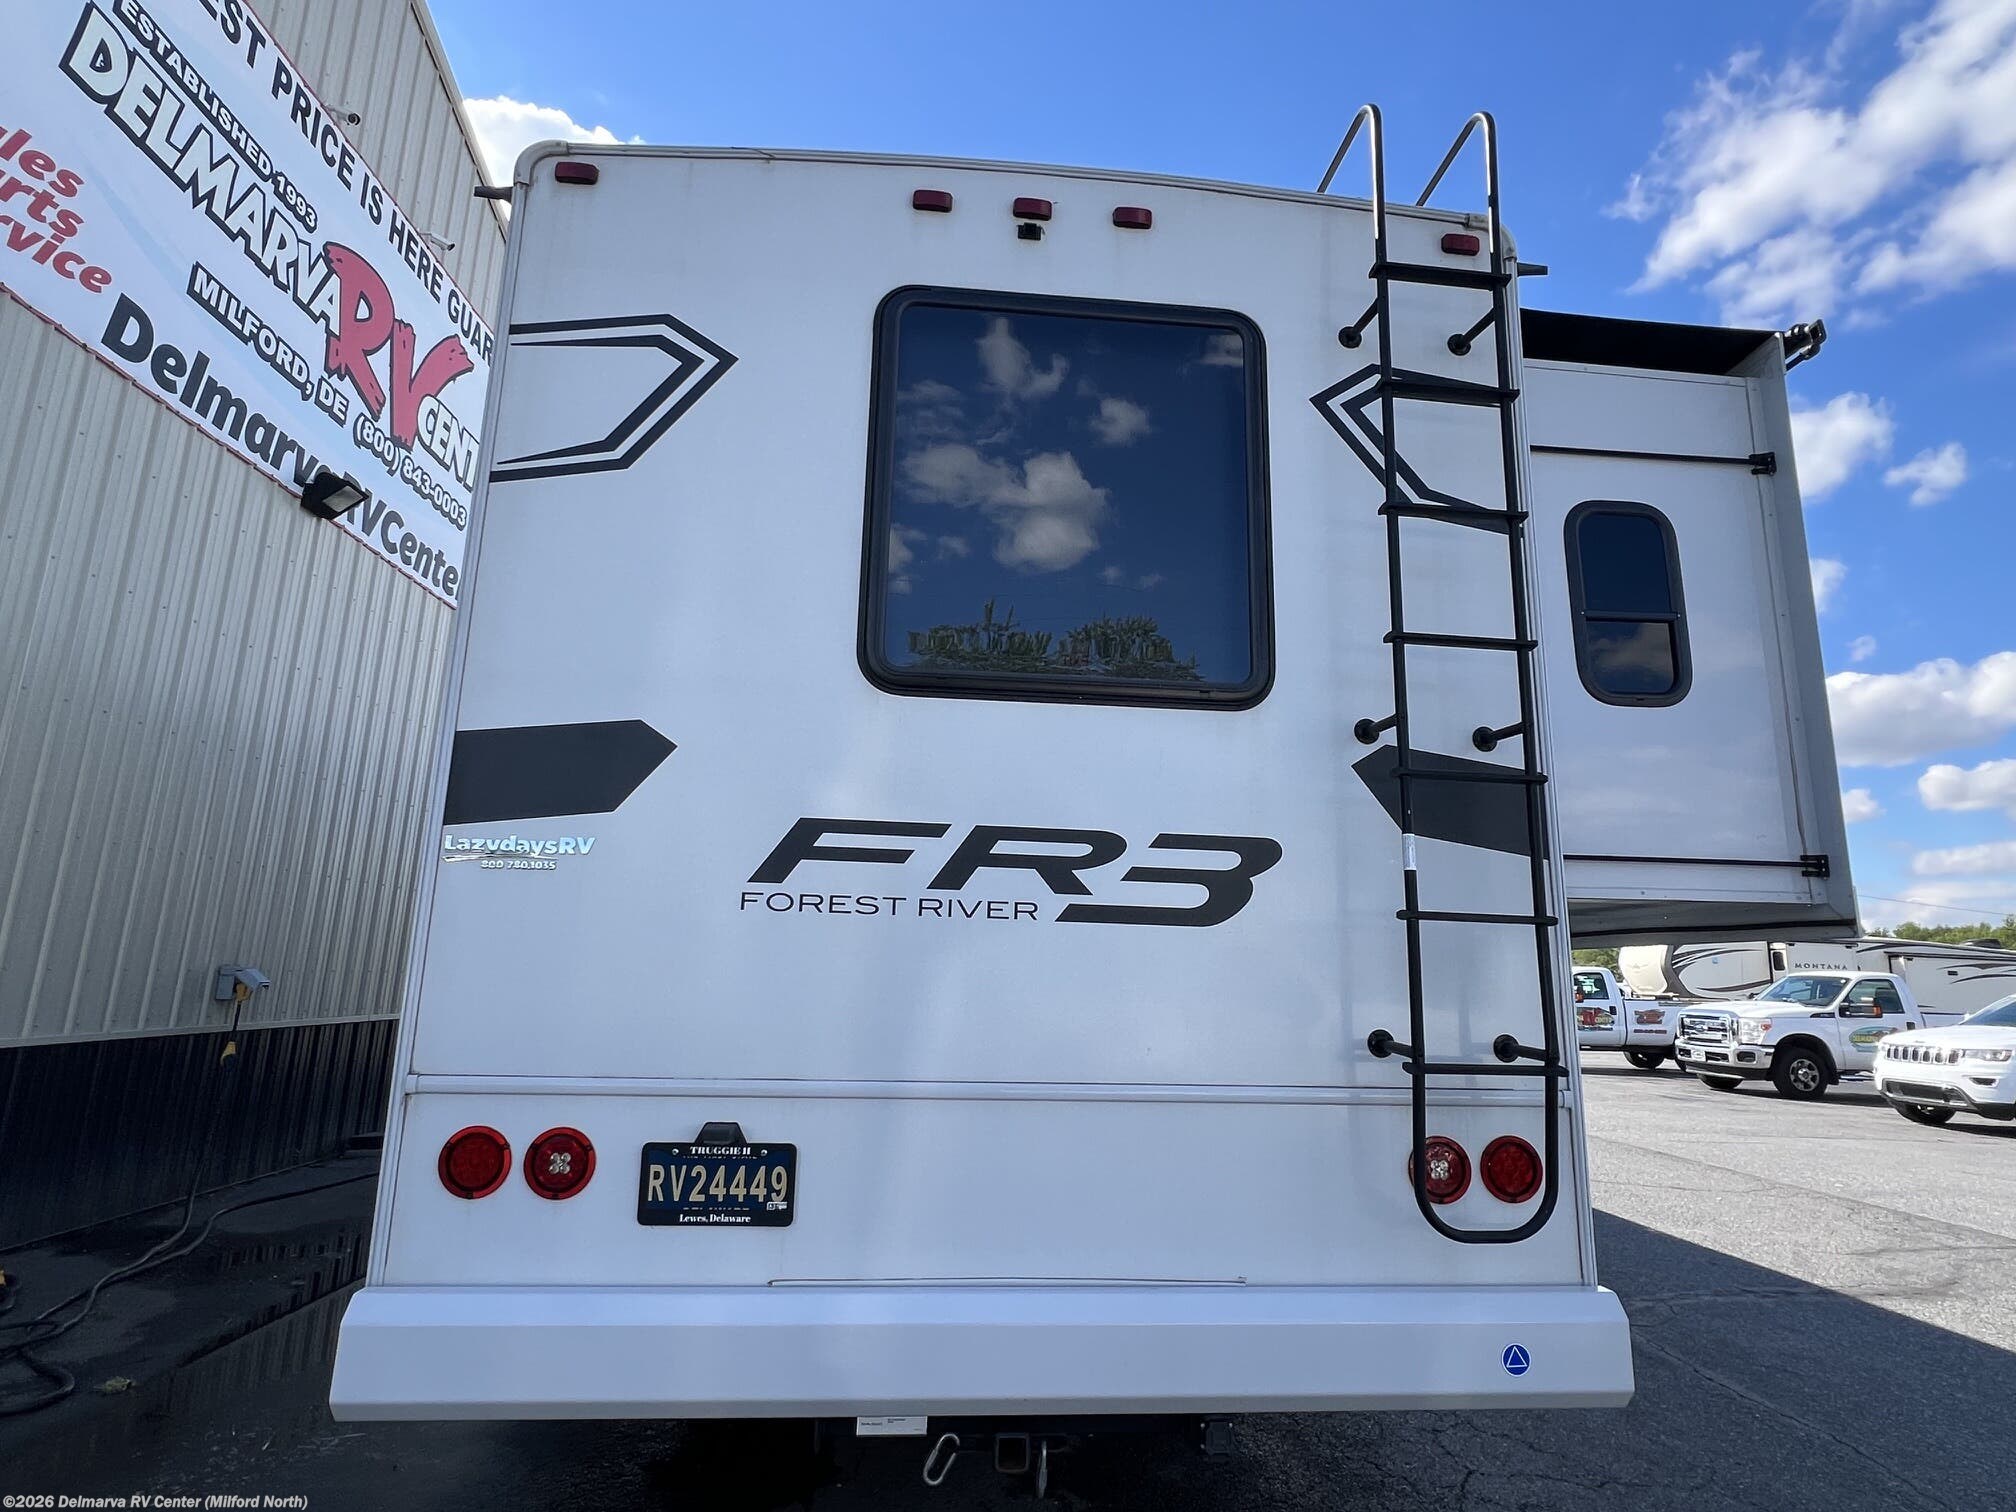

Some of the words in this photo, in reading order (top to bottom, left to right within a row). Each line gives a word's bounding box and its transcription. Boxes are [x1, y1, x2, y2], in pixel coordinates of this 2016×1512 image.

[116, 0, 273, 182] ESTABLISHED
[274, 170, 318, 233] 1993
[0, 127, 85, 198] les
[272, 56, 356, 192] PRICE
[360, 181, 384, 226] IS
[388, 213, 444, 305] HERE
[0, 169, 85, 238] rts
[59, 2, 342, 338] DELMARVA
[322, 241, 475, 453] RV
[187, 262, 315, 402] MILFORD,
[315, 374, 349, 427] DE
[353, 412, 401, 477] (800)
[401, 454, 468, 531] 843-0003
[740, 891, 907, 917] FOREST
[917, 898, 1039, 921] RIVER
[747, 817, 1283, 928] FR3
[1794, 962, 1848, 970] MONTANA
[647, 1164, 788, 1203] RV24449
[709, 1213, 752, 1224] Delaware
